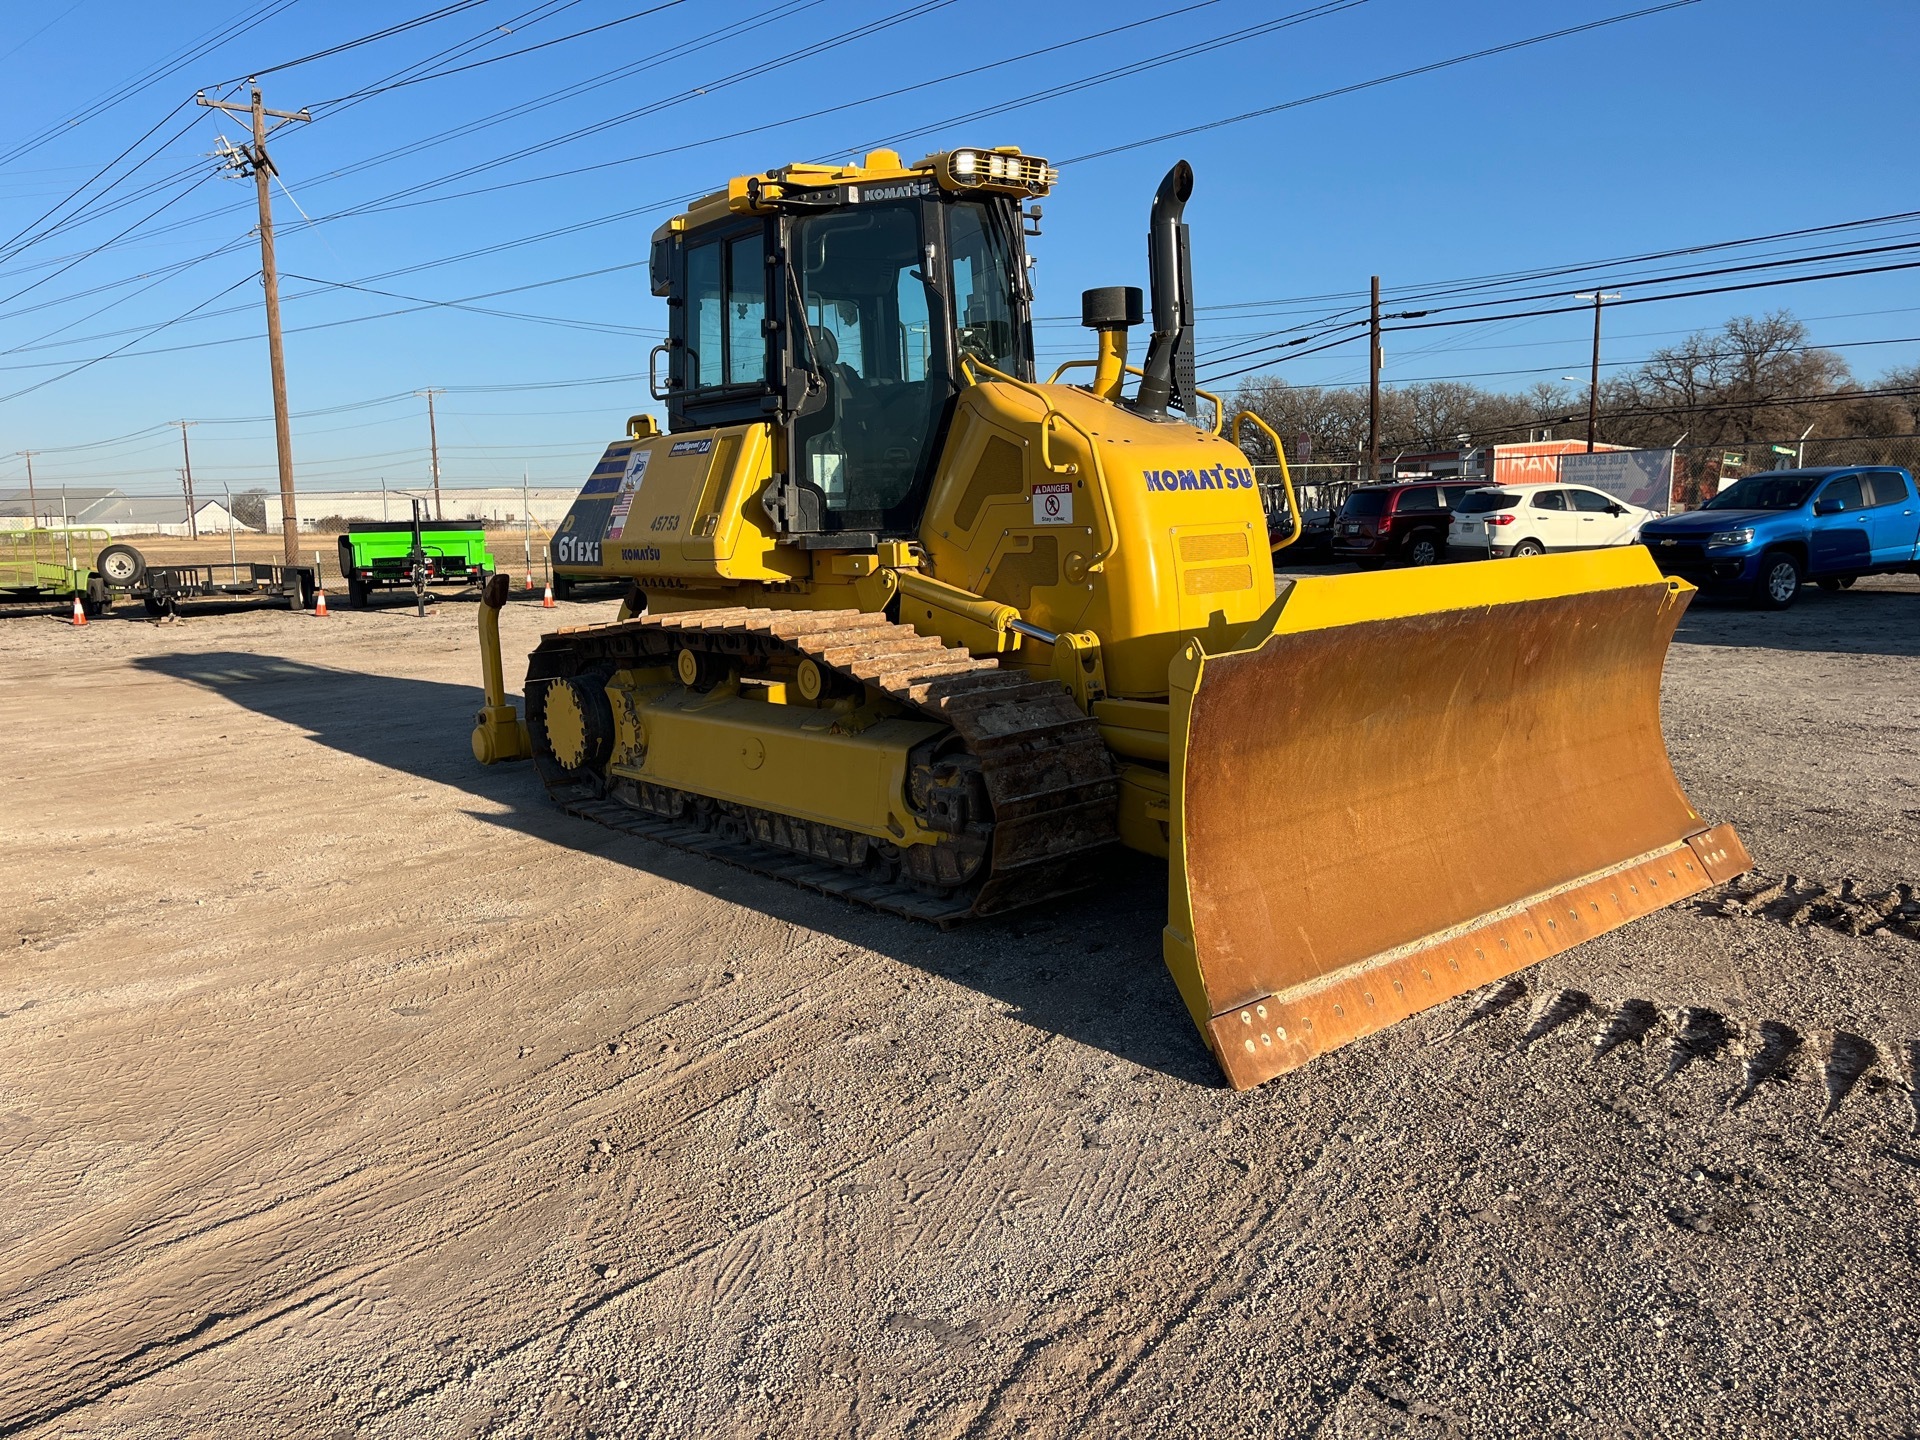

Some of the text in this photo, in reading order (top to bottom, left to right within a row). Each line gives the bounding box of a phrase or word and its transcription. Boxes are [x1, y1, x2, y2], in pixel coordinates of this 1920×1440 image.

[864, 183, 930, 201] KOMATSU
[699, 441, 711, 452] 2.0
[1143, 463, 1253, 491] KOMATSU
[1041, 484, 1070, 493] DANGER
[562, 514, 576, 532] D
[650, 515, 680, 531] 45753
[558, 536, 599, 562] 61EXi
[621, 545, 660, 560] KOMATSU
